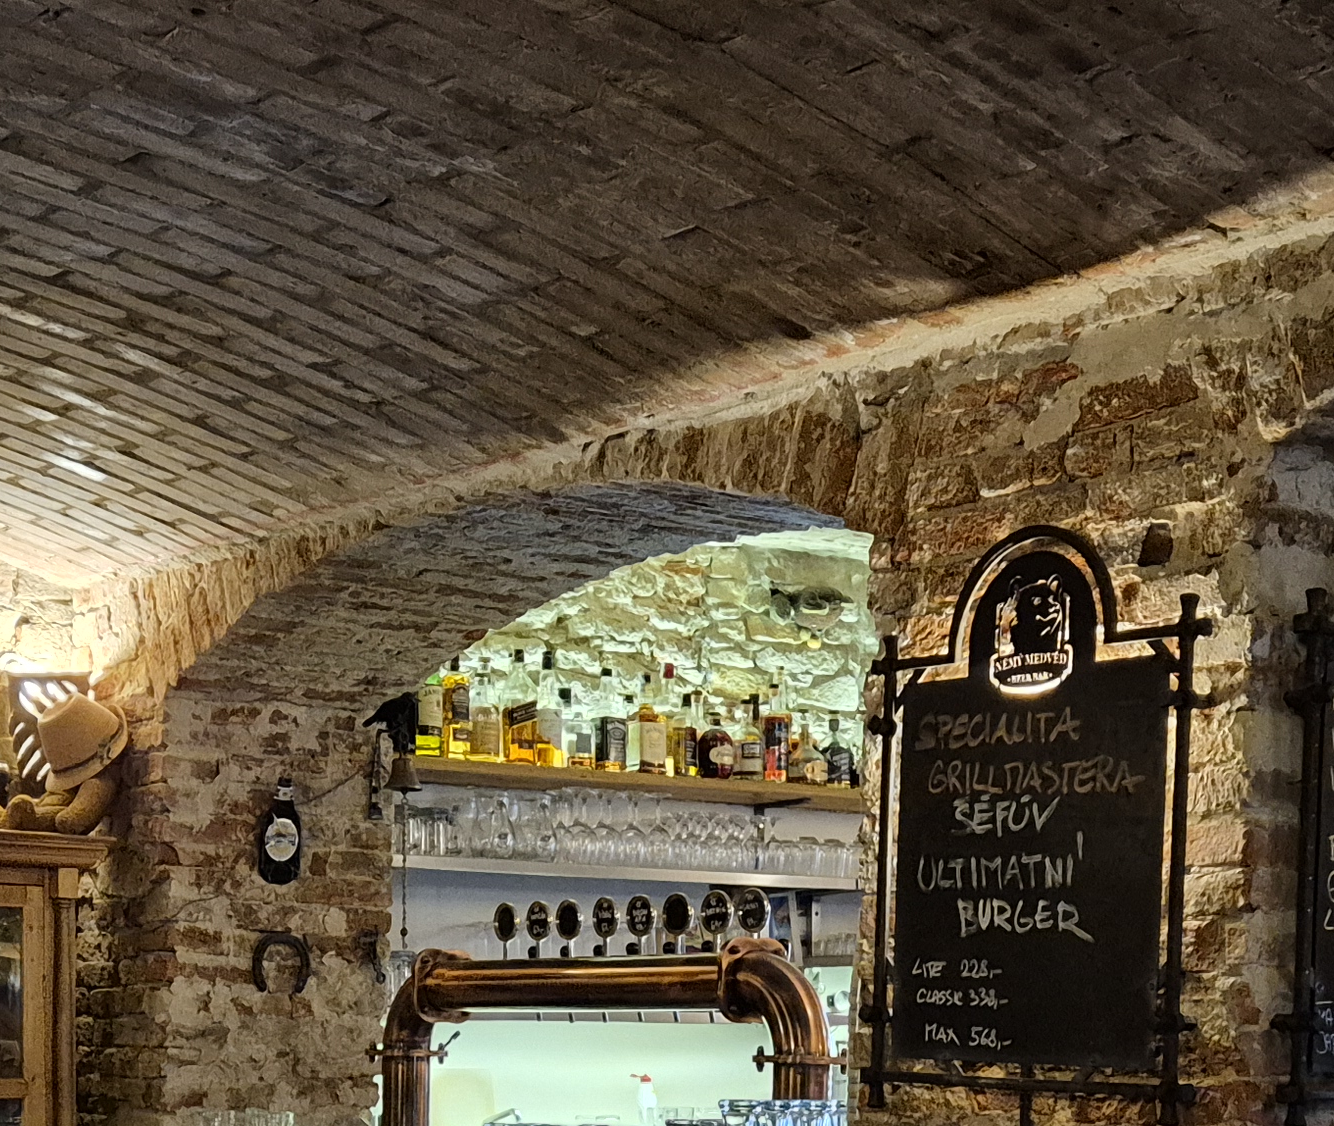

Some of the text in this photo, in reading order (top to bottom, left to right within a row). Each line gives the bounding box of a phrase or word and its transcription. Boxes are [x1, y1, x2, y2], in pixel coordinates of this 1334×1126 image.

[913, 706, 1081, 752] SPECIALITA
[956, 897, 1097, 944] BURGER
[911, 957, 1003, 980] LITE 228,-
[968, 986, 1010, 1010] 338,-
[924, 1022, 1014, 1052] MAX 568,-
